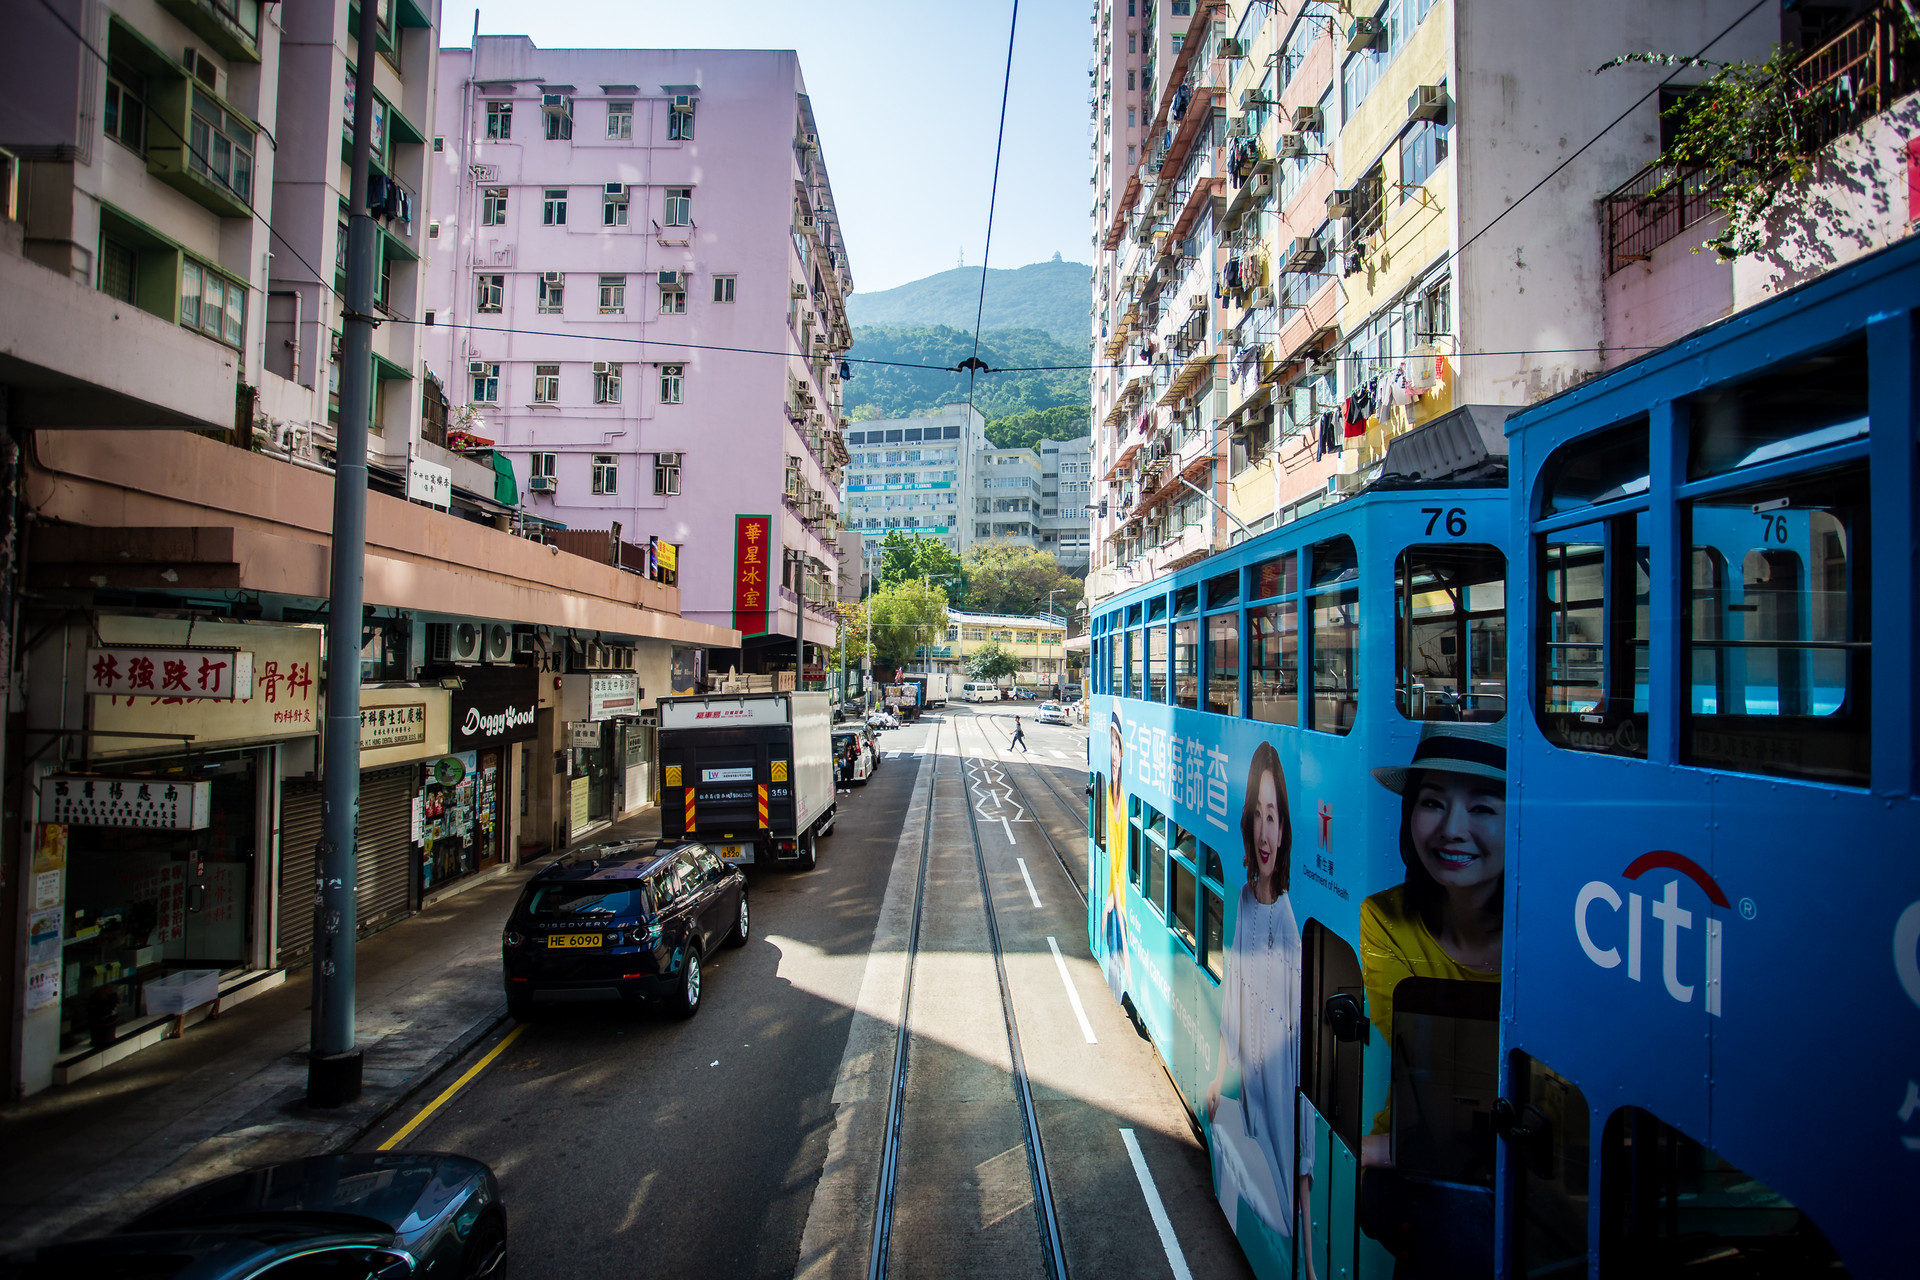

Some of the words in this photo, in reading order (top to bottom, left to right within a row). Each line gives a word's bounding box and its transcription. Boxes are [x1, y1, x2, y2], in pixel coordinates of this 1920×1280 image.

[1421, 508, 1467, 536] 76
[1761, 514, 1788, 544] 76
[742, 522, 762, 607] 華星冰室
[93, 654, 227, 692] 林強跌打
[394, 735, 408, 743] SURGEON
[55, 781, 178, 801] 西醫楊應南
[1125, 720, 1229, 832] 子宮頸癌篩查
[771, 788, 788, 797] 359
[1303, 864, 1328, 888] Department
[1334, 883, 1350, 902] Health
[539, 921, 610, 929] DISCOVERY
[550, 936, 566, 946] HE
[569, 936, 600, 946] 6090
[1574, 879, 1723, 1018] citi
[1130, 933, 1149, 972] cervical
[1149, 963, 1171, 1004] cancer
[1171, 991, 1211, 1071] screening
